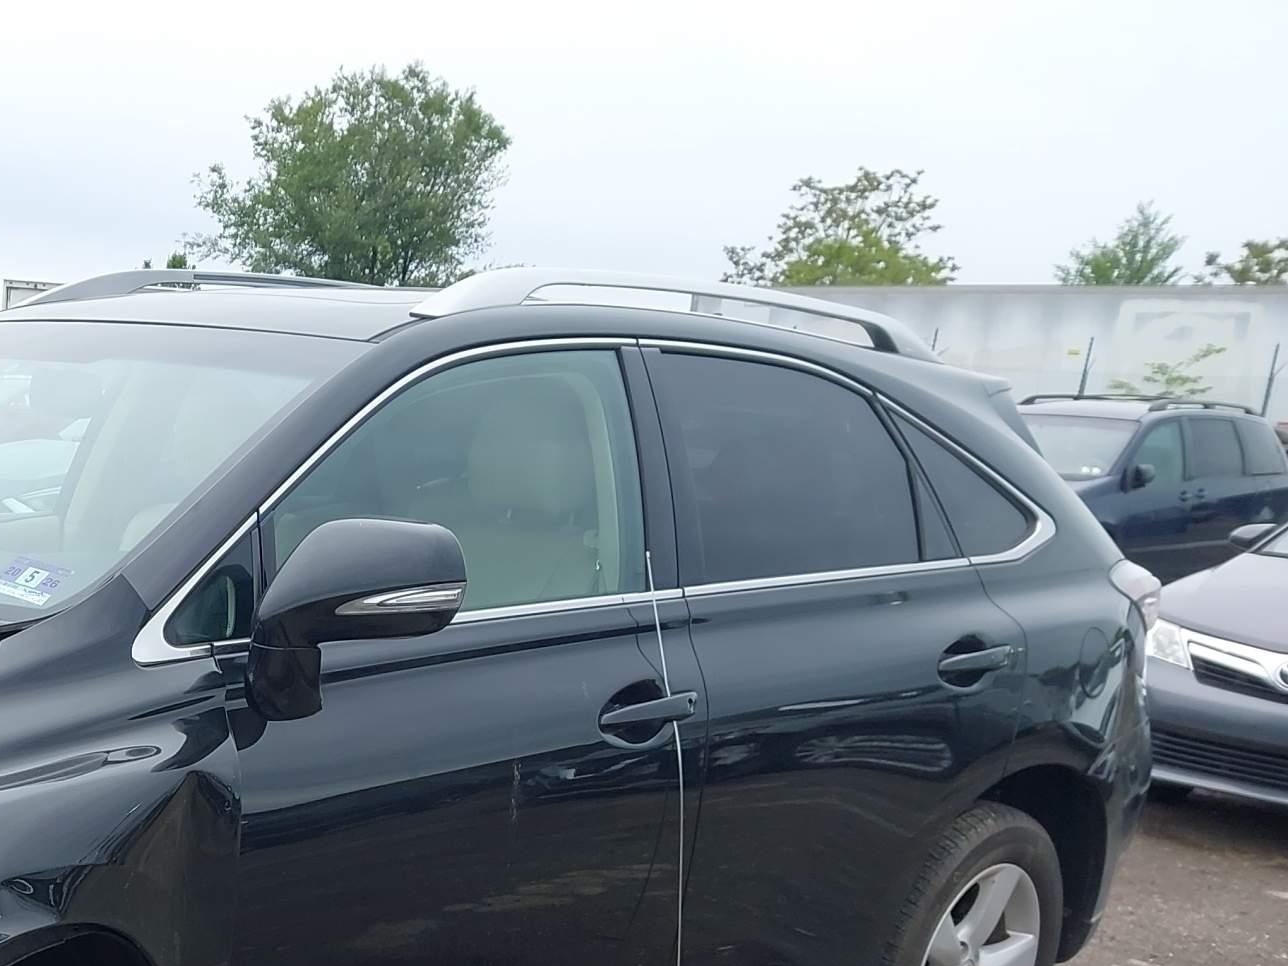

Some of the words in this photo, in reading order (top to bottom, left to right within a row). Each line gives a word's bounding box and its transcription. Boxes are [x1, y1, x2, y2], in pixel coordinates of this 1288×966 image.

[6, 566, 22, 577] 20
[24, 570, 40, 584] 5
[42, 577, 60, 589] 26
